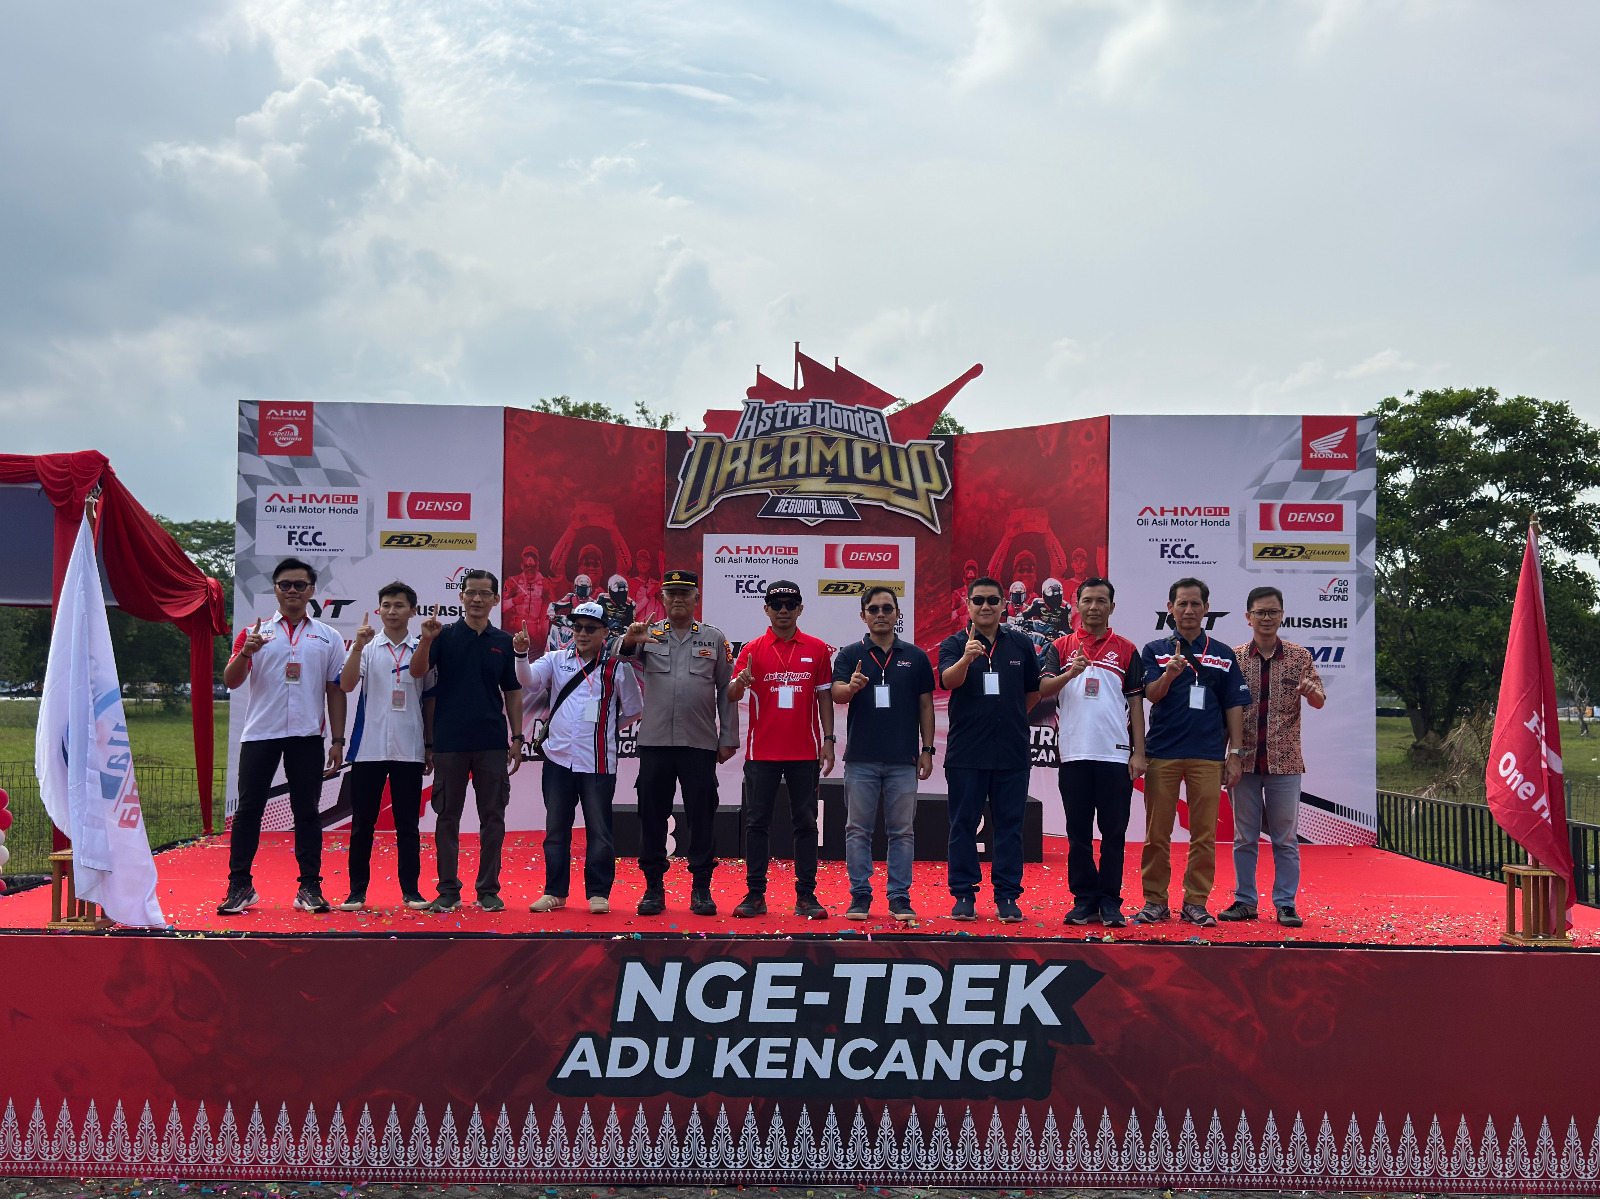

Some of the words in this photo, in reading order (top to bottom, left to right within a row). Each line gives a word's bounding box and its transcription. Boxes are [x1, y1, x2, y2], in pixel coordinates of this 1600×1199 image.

[736, 401, 810, 439] Astra
[813, 402, 886, 442] Honda
[264, 505, 277, 513] Oli
[279, 505, 296, 513] Asli
[298, 506, 326, 514] Motor
[415, 501, 463, 512] DENSO
[774, 499, 820, 514] REGIONAL
[821, 500, 843, 515] RIAU
[1136, 518, 1149, 526] Oli
[1151, 518, 1168, 526] Asli
[1170, 518, 1198, 526] Motor
[1200, 518, 1230, 527] Honda
[1287, 512, 1335, 523] DENSO
[287, 530, 326, 546] F.C.C.
[383, 533, 432, 547] FDR
[849, 552, 892, 561] DENSO
[1159, 543, 1199, 559] F.C.C.
[1255, 544, 1305, 559] FDR
[714, 556, 726, 564] Oli
[727, 556, 743, 564] Asli
[1337, 579, 1349, 587] GO
[1319, 594, 1349, 602] BEYOND
[1498, 751, 1536, 801] One
[617, 961, 1068, 1027] NGE-TREK
[556, 1036, 696, 1080] ADU
[711, 1038, 1029, 1084] KENCANG!
